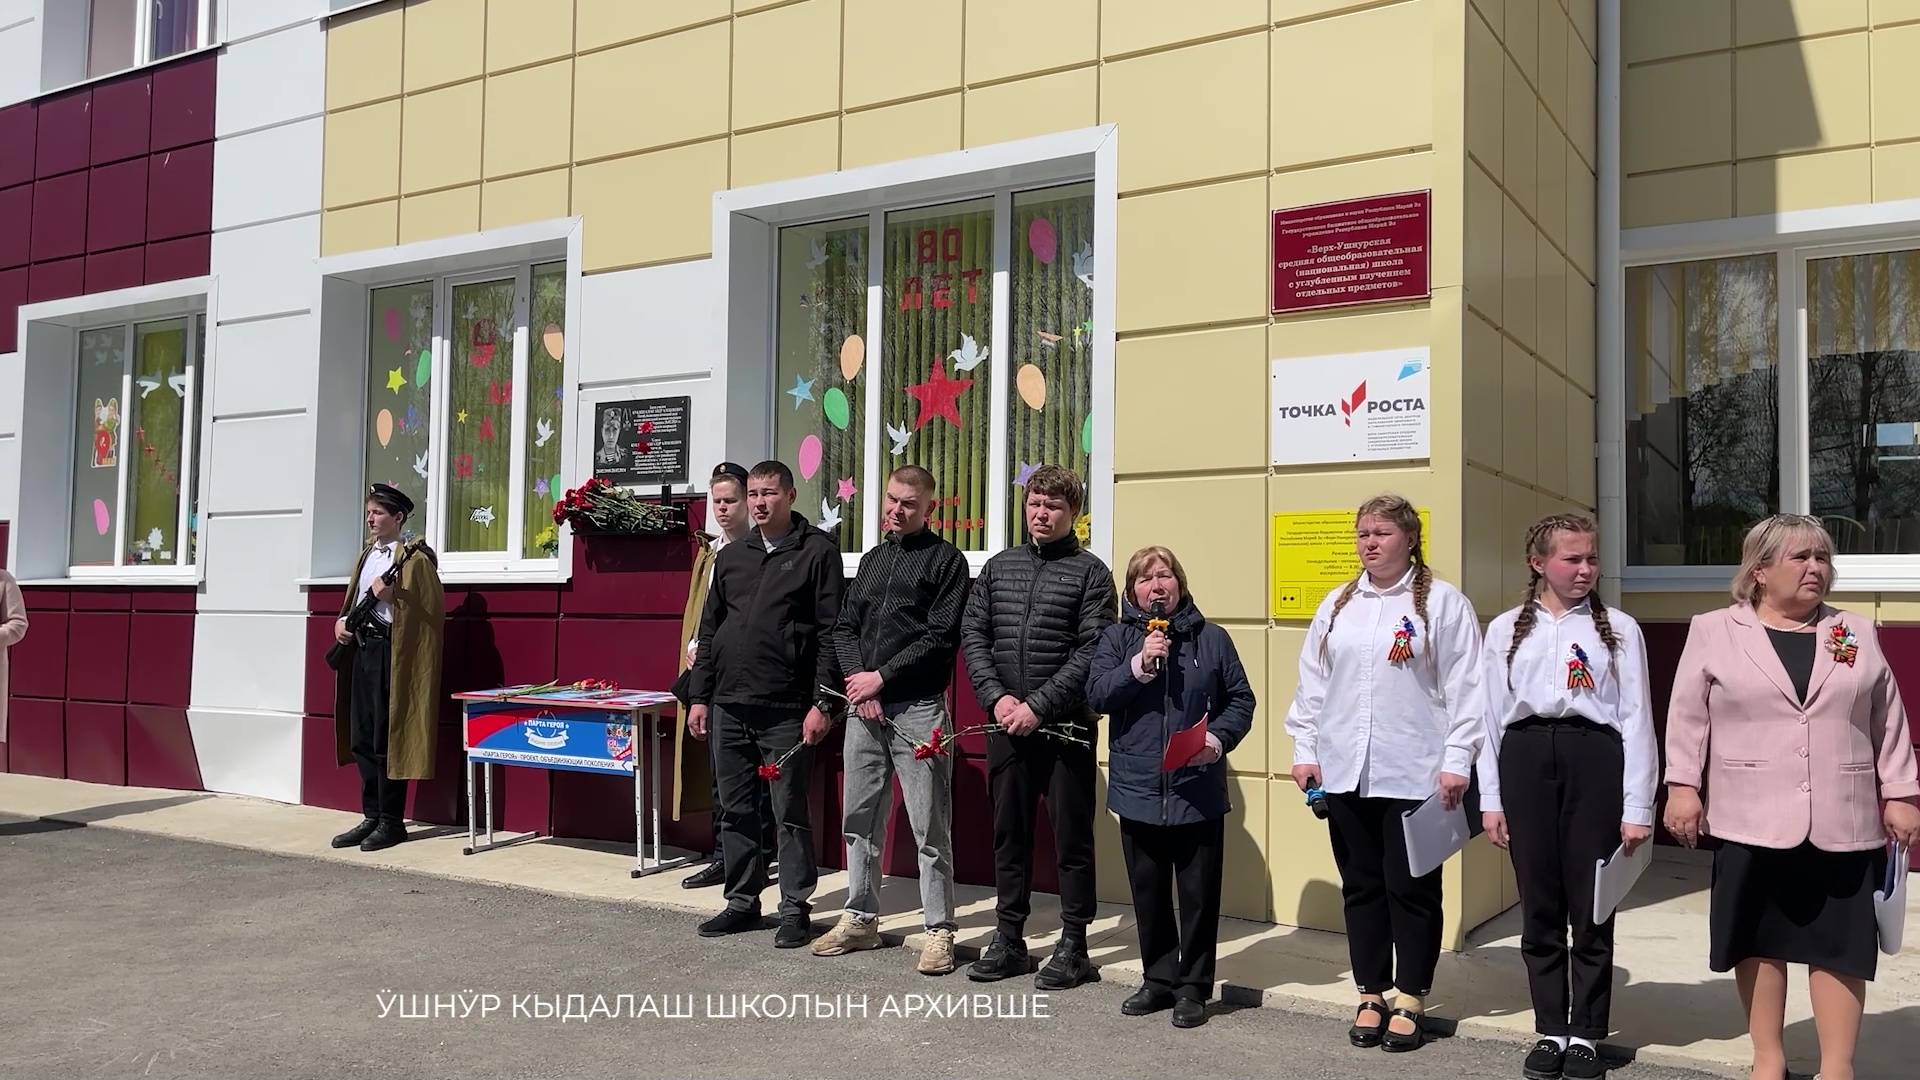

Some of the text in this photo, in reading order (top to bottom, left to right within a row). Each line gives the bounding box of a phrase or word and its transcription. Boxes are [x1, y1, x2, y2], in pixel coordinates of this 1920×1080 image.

[917, 227, 963, 264] 80
[1278, 245, 1422, 270] средняя общеобразовательная
[1295, 258, 1404, 277] (национальная) школа
[1295, 274, 1358, 289] углубленным
[1359, 269, 1411, 281] изучением
[1295, 281, 1403, 298] отдельных предметов»
[1279, 398, 1425, 419] ТОЧКА РОСТА
[528, 719, 565, 729] ПАРТА ГЕРОЯ
